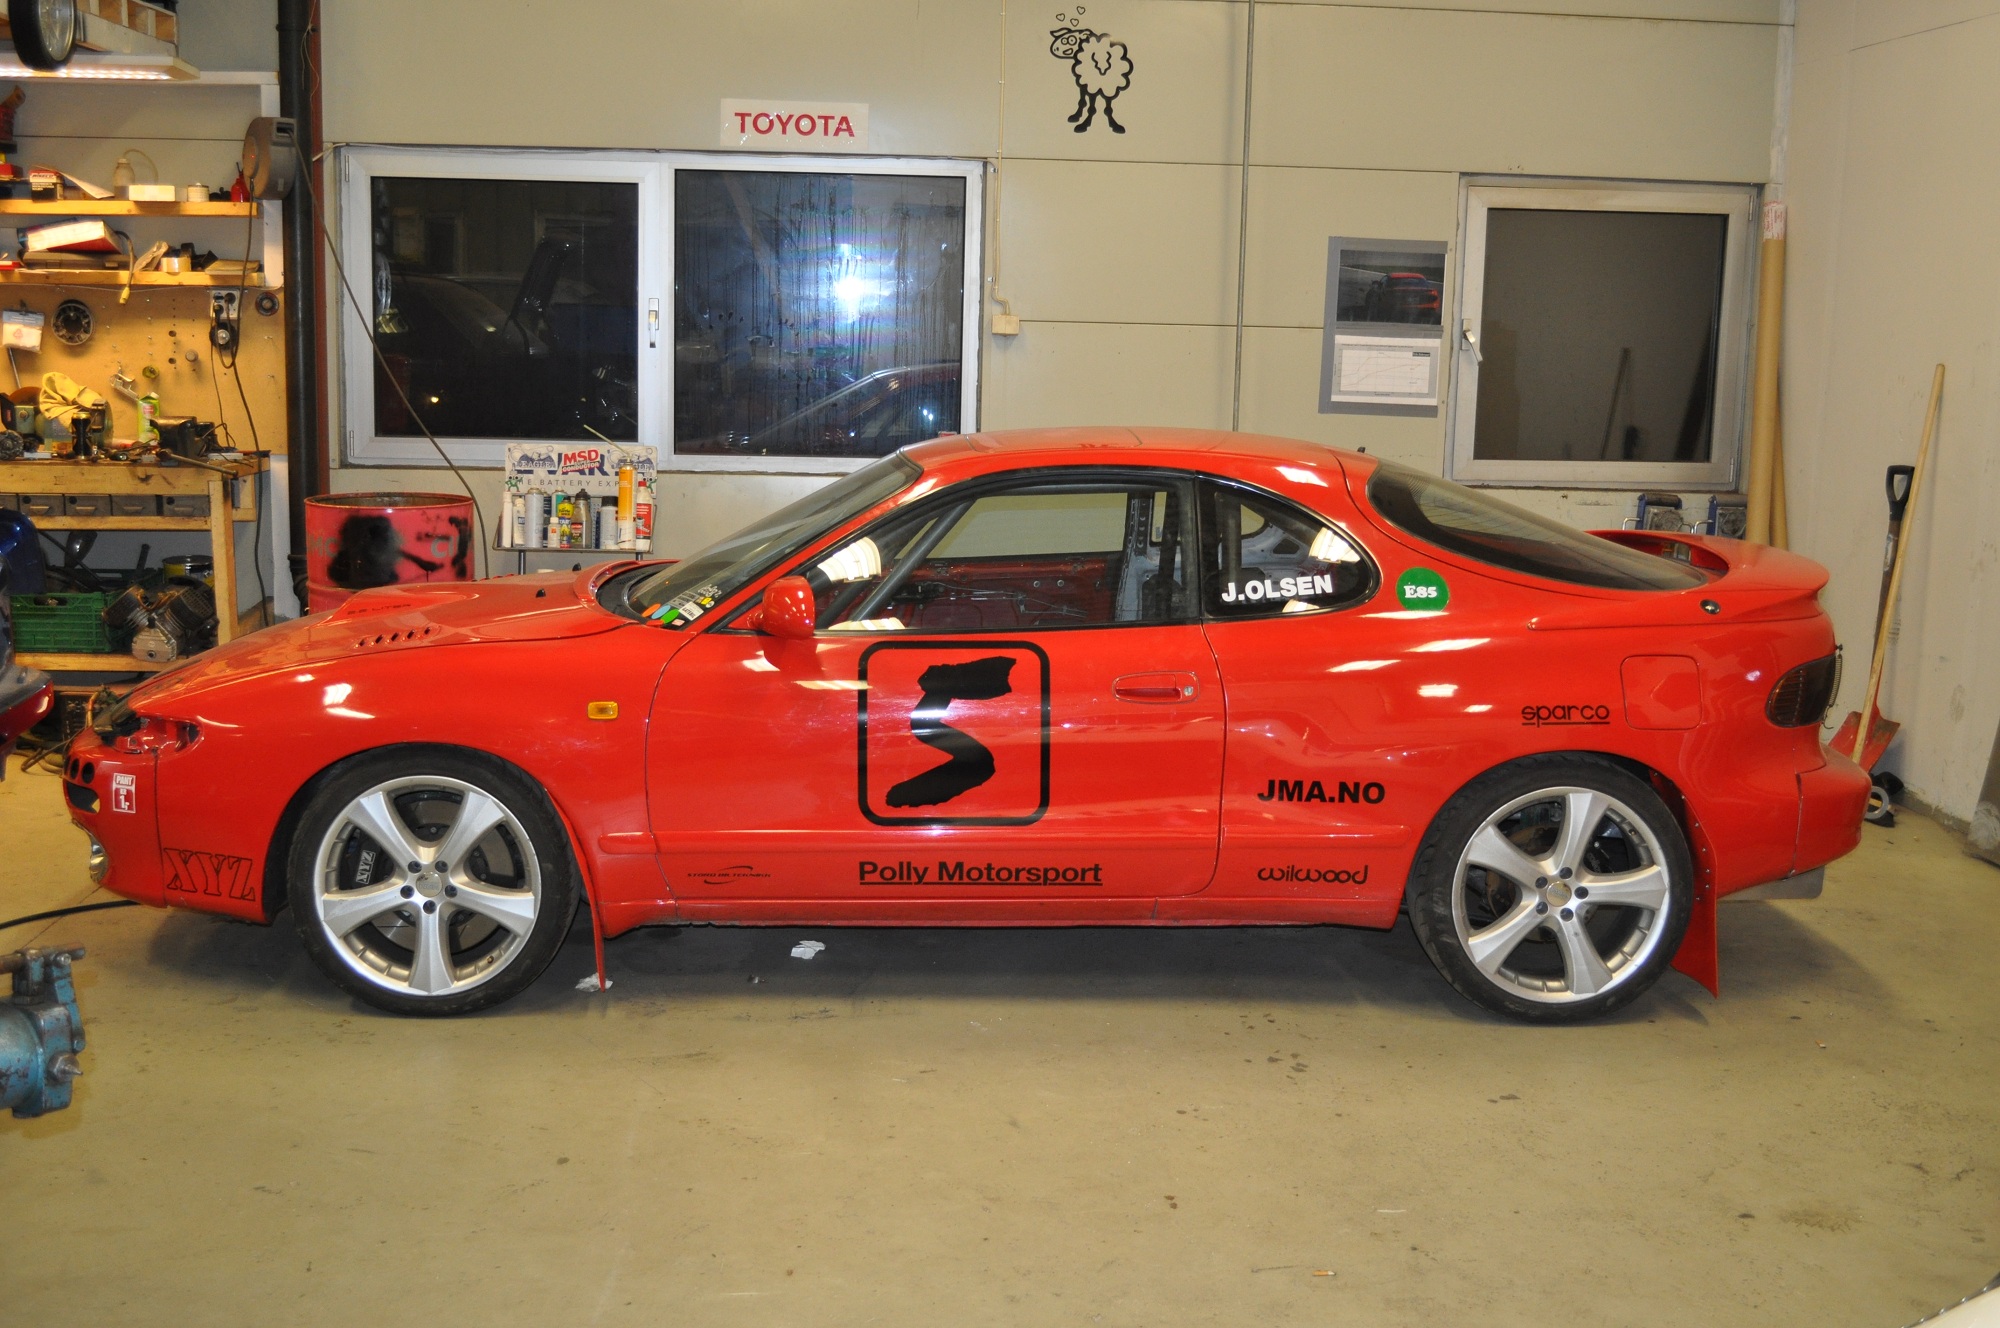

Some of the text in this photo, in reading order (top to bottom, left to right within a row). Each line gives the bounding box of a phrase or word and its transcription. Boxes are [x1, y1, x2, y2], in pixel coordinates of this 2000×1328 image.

[734, 112, 855, 138] TOYOTA
[520, 460, 551, 468] EAGLE
[562, 462, 600, 472] CONDUCTOR
[563, 449, 599, 465] MSD
[540, 479, 590, 487] BATTERY
[1221, 574, 1333, 602] J.OLSEN
[1403, 585, 1438, 599] E85
[1521, 704, 1610, 727] sparco
[885, 655, 1017, 808] 5
[115, 774, 133, 786] PANT
[1257, 779, 1385, 804] JMA.NO
[163, 847, 256, 902] XYZ
[356, 849, 376, 885] XYZ
[859, 861, 1103, 886] Polly Motorsport
[1257, 864, 1369, 885] wilwood
